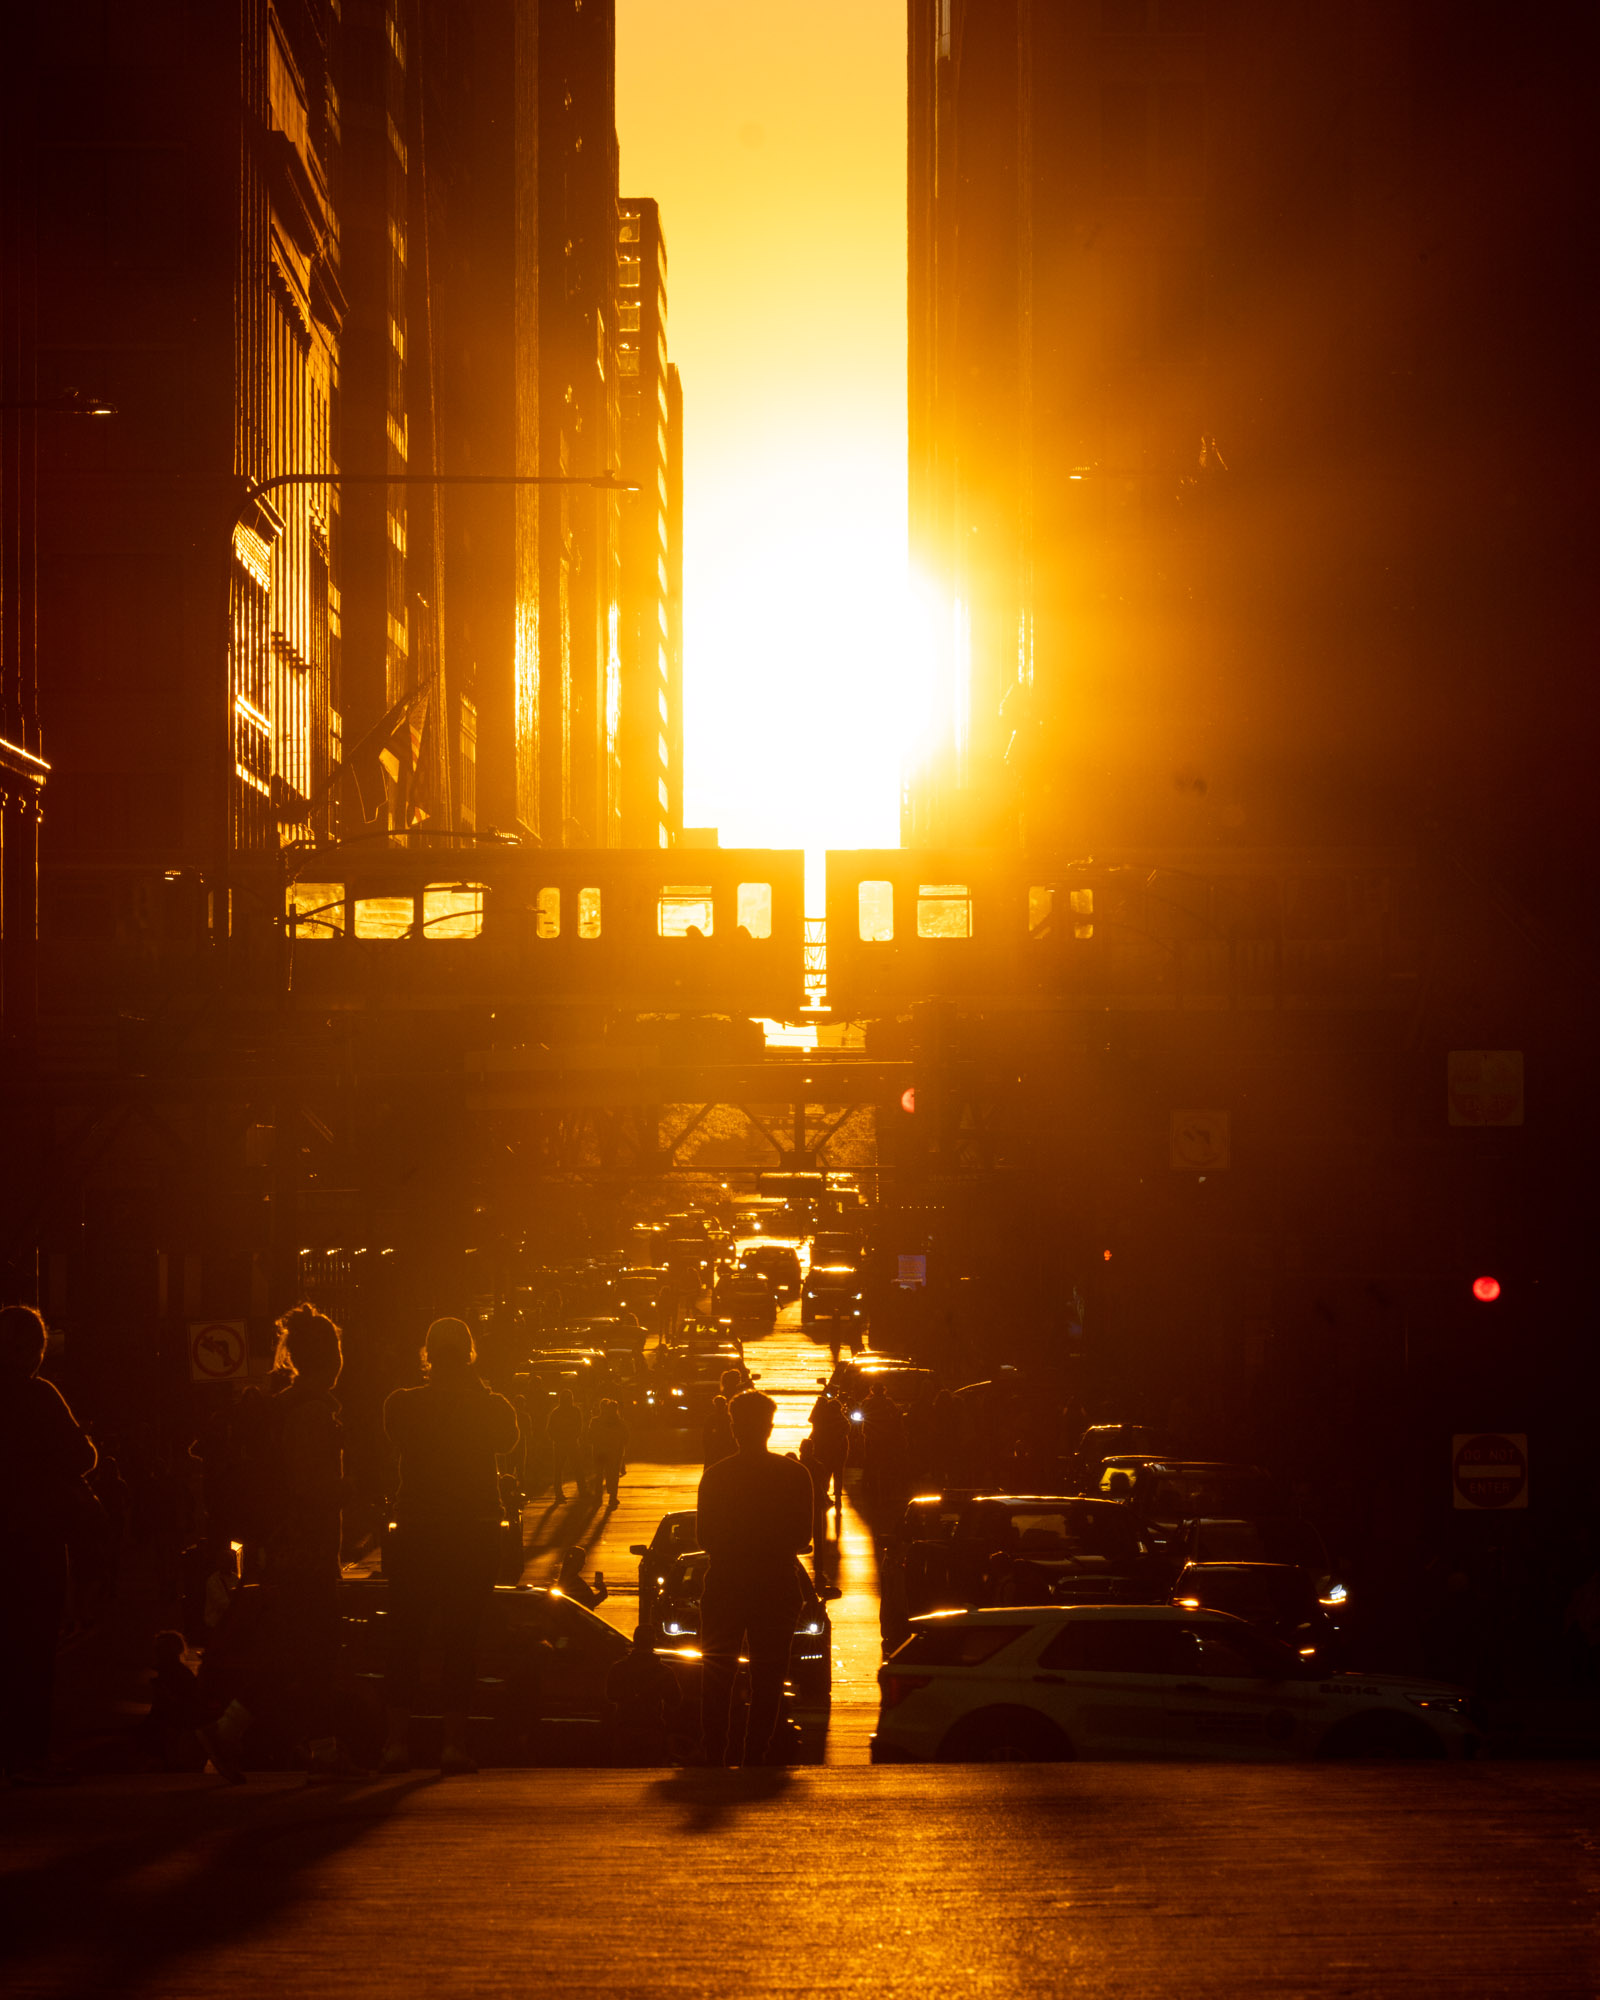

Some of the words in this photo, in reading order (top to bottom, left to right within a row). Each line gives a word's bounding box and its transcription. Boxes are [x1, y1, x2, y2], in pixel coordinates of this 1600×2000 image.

[1463, 1449, 1481, 1461] DO
[1489, 1449, 1515, 1461] NOT
[1469, 1481, 1511, 1494] ENTER
